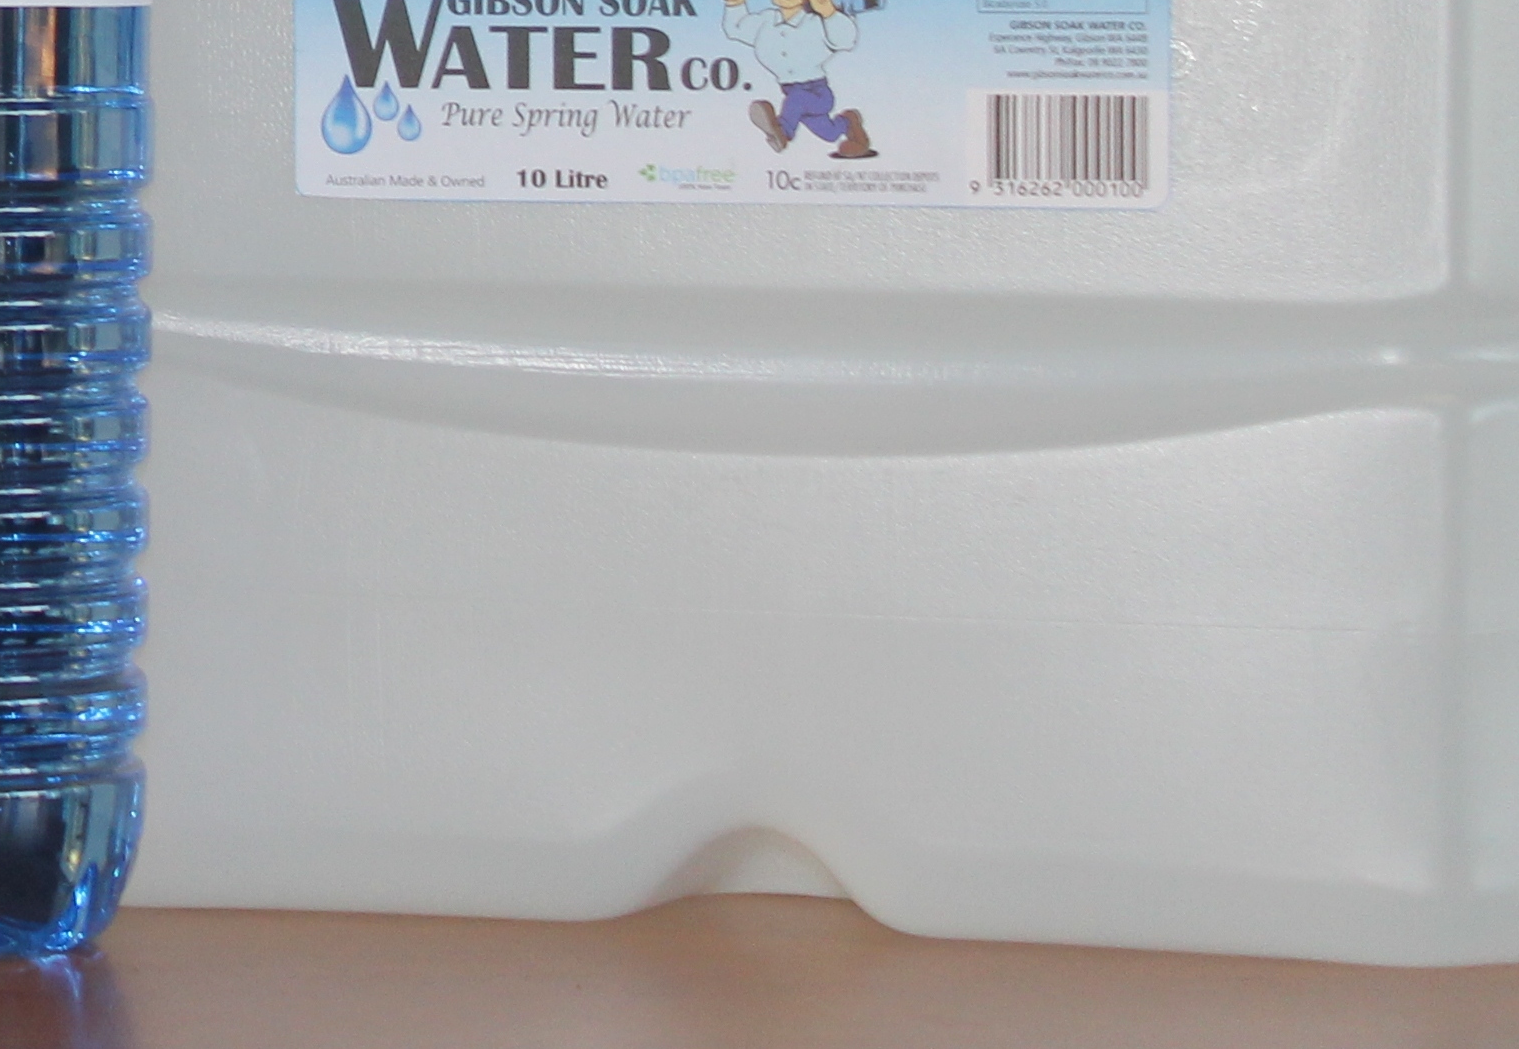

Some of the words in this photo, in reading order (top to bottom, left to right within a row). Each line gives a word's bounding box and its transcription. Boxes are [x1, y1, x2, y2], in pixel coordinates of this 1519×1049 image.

[681, 58, 751, 91] CO.
[442, 102, 503, 127] Pure
[512, 102, 598, 137] Spring
[609, 100, 692, 128] Water
[326, 174, 384, 187] Australian
[389, 174, 423, 187] Made
[428, 175, 437, 187] &
[441, 175, 485, 187] Owned
[517, 169, 546, 188] 10
[555, 169, 608, 188] Litre
[660, 167, 735, 184] bpafree
[766, 170, 801, 191] 10c
[969, 180, 980, 194] 9
[993, 181, 1063, 196] 316262
[1072, 182, 1143, 197] 000100
